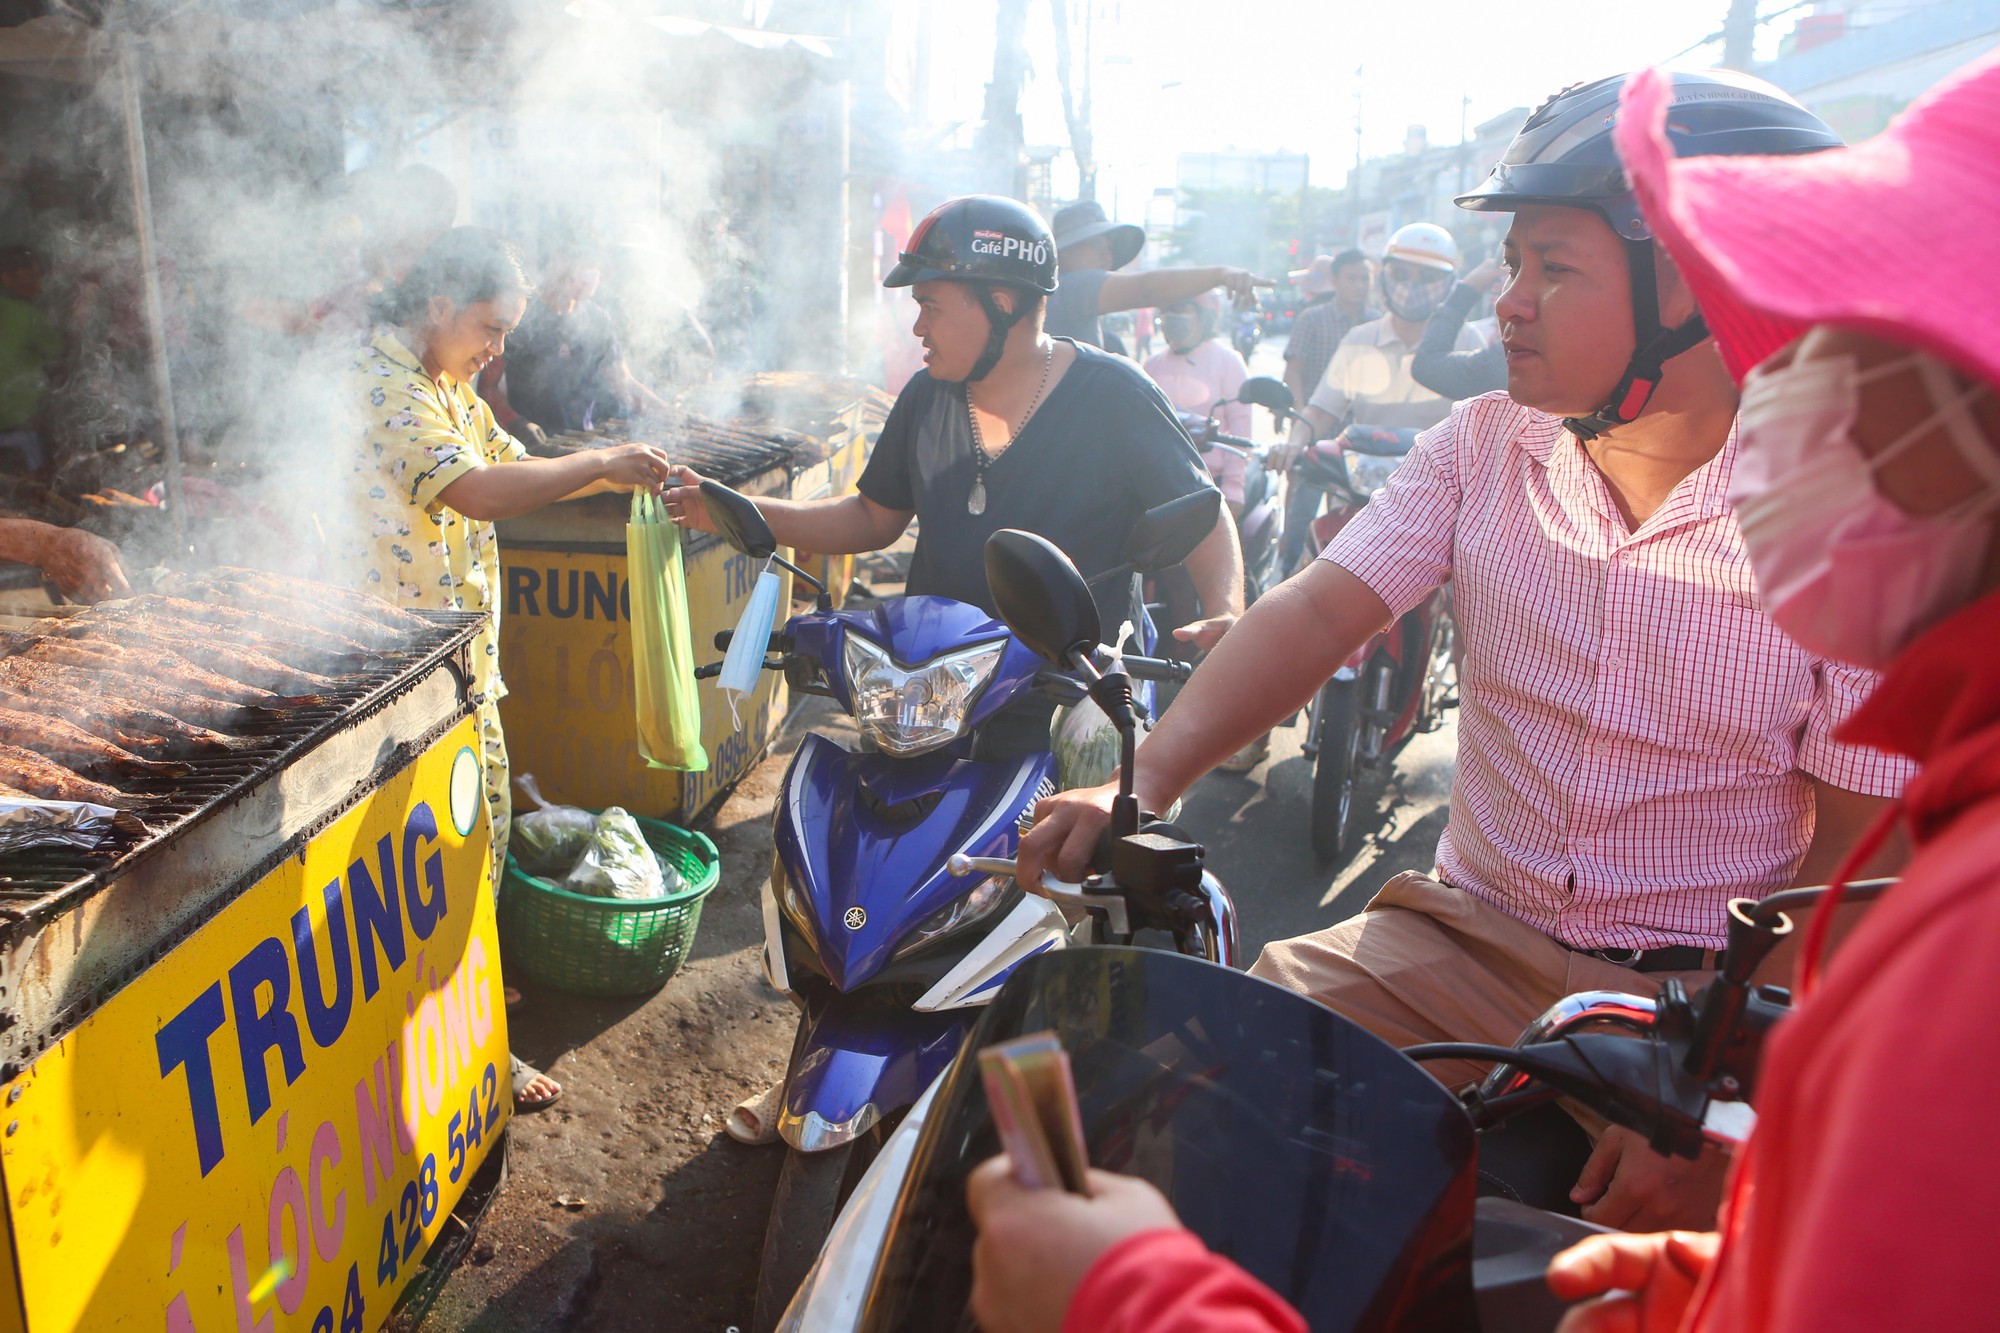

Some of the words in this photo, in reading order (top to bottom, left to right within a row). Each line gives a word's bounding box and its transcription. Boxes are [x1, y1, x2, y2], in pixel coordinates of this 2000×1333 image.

[971, 239, 1002, 255] Café
[504, 564, 631, 623] RUN
[155, 801, 446, 1178] TRUNG
[226, 1110, 347, 1333] LÓC
[355, 935, 493, 1208] NƯỚNG
[377, 1153, 439, 1288] 428
[448, 1062, 500, 1184] 542
